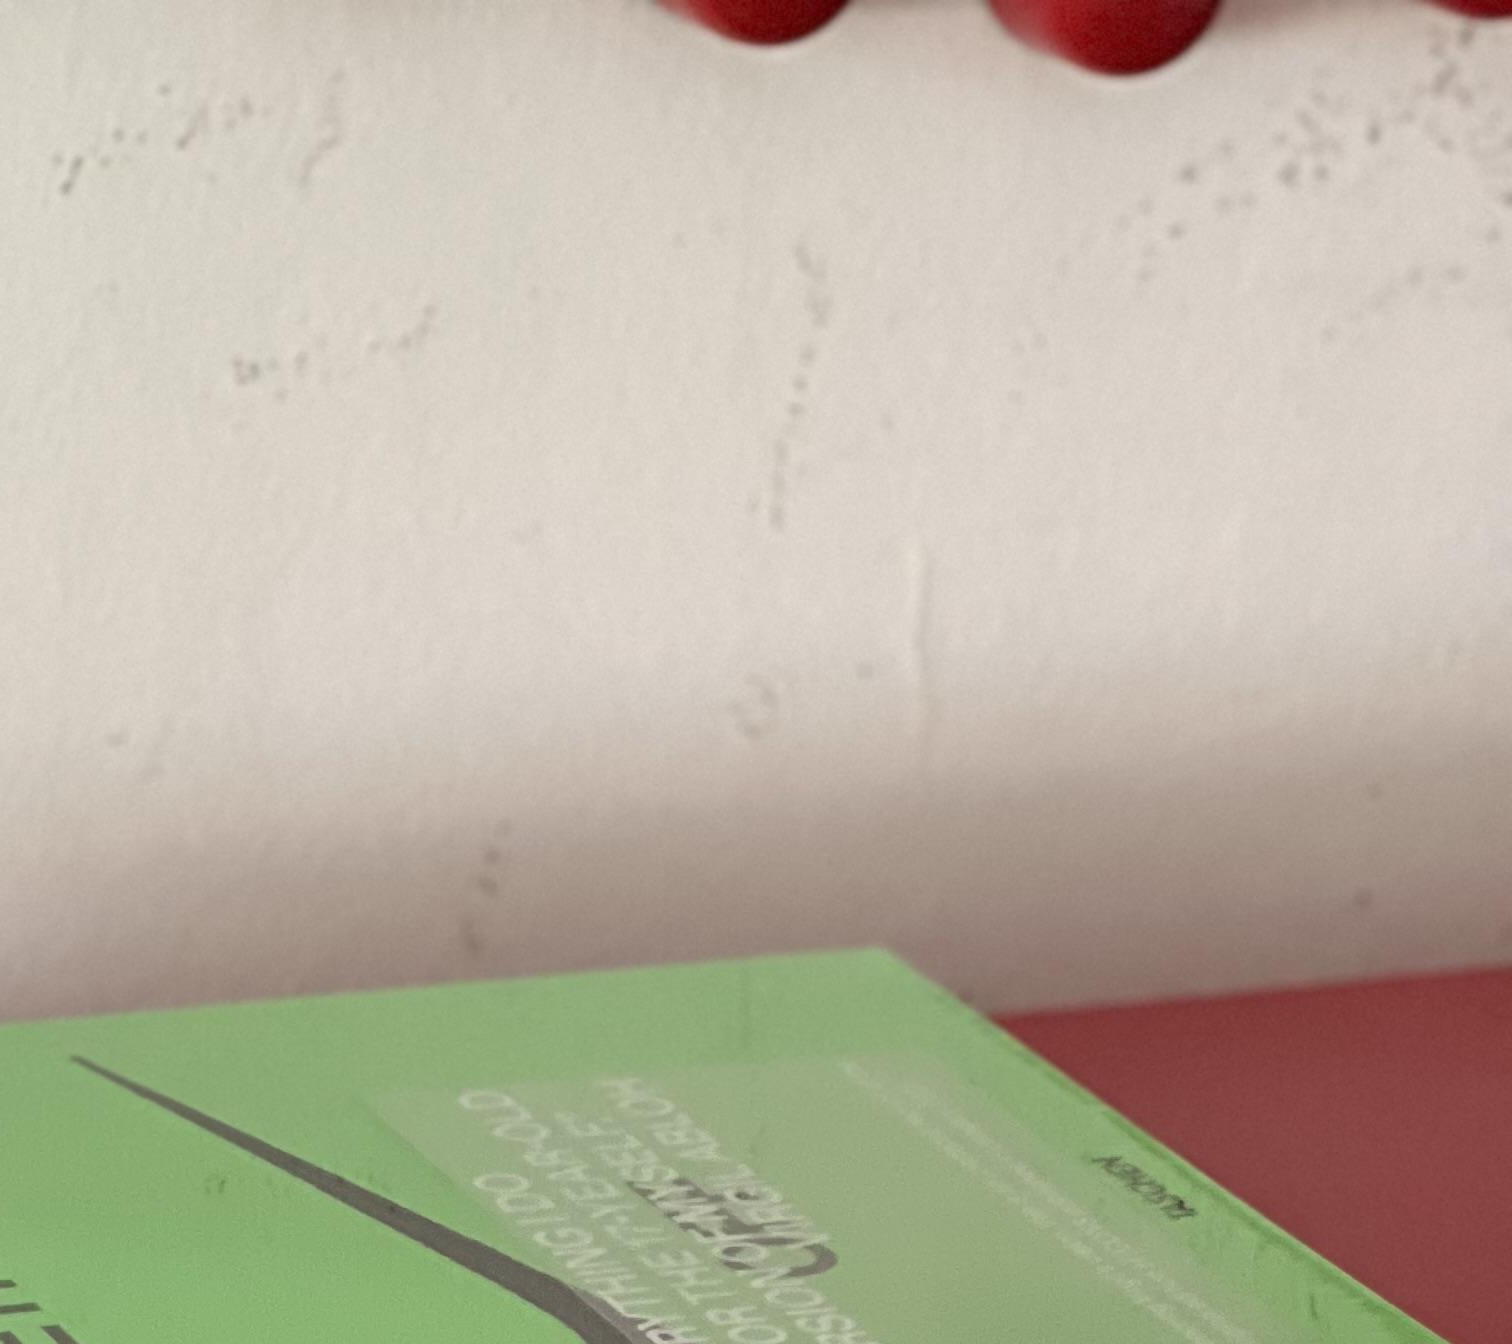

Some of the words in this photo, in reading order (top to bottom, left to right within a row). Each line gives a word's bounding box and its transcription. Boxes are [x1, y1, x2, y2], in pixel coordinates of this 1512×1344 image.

[592, 1078, 728, 1158] ABLOH
[473, 1172, 559, 1214] DO
[702, 1164, 832, 1248] VIRGIL
[1091, 1156, 1197, 1220] TASCHEN
[515, 1216, 572, 1225] I
[683, 1229, 767, 1260] OF
[636, 1249, 740, 1304] THE
